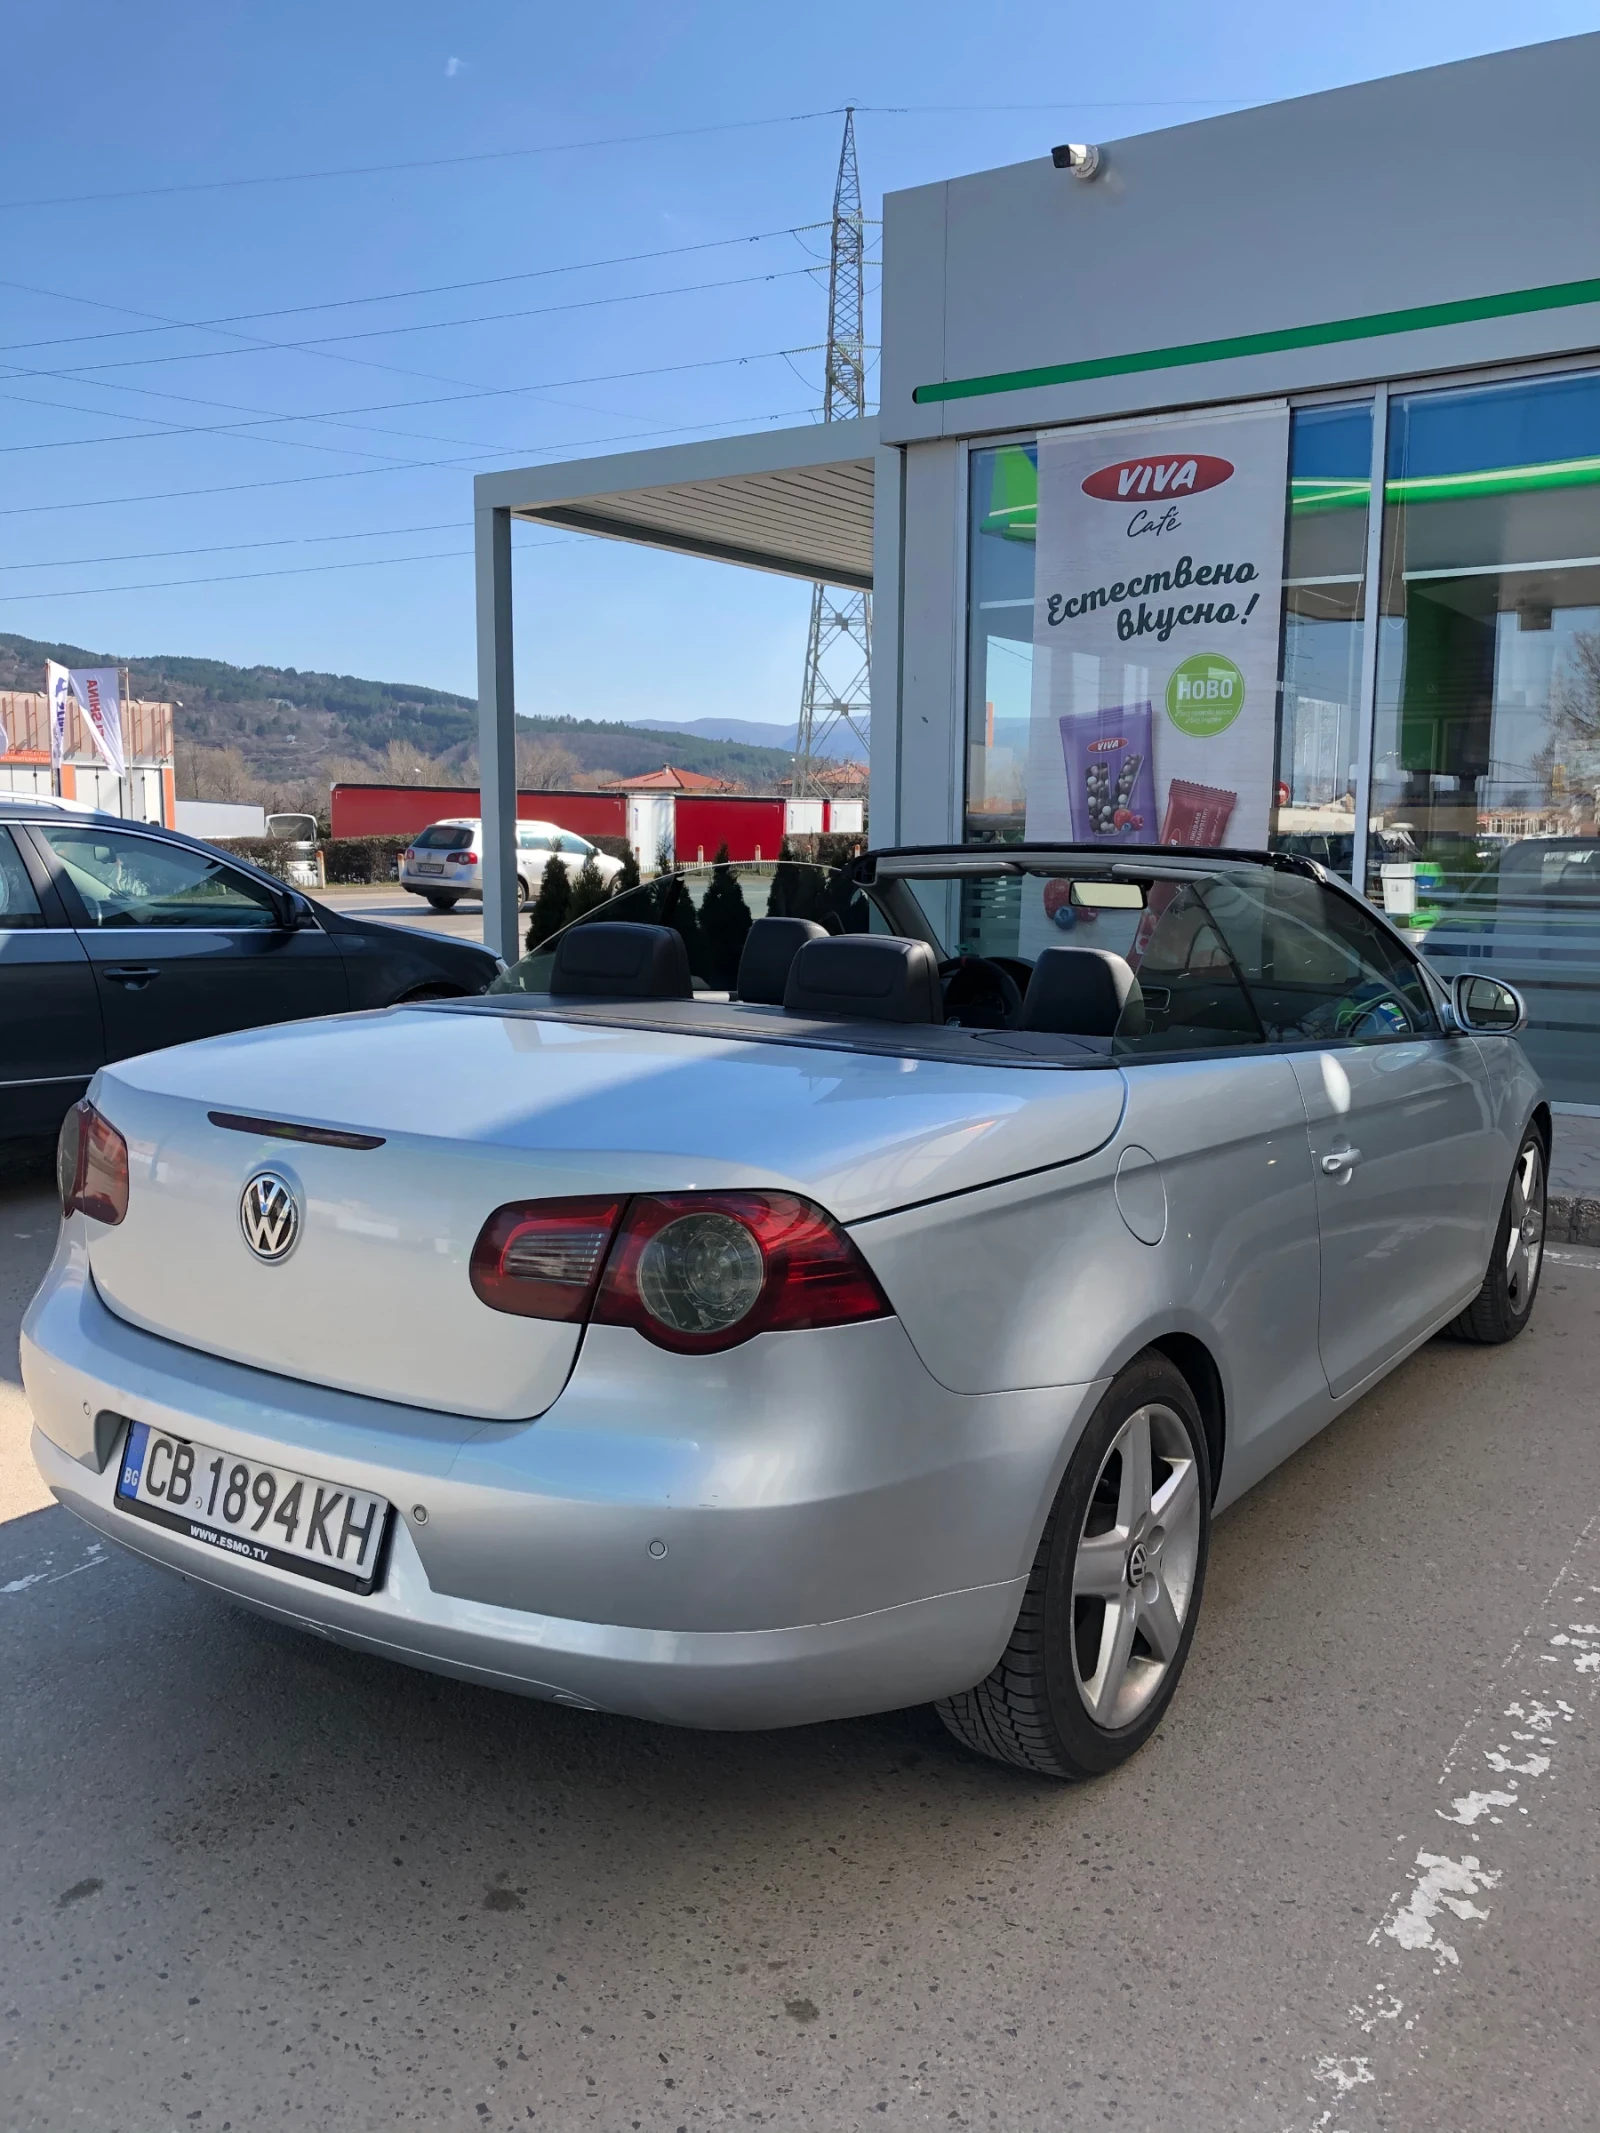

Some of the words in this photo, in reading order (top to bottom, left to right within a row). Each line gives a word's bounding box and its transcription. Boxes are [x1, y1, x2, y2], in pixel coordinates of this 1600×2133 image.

[1117, 460, 1198, 496] VIVA
[1127, 506, 1182, 538] Café
[1047, 555, 1260, 627] Естествено
[1116, 593, 1261, 642] вкусно!
[1178, 678, 1233, 700] НОВО
[1097, 740, 1119, 751] VIVA
[124, 1467, 139, 1488] BG
[190, 1525, 269, 1561] WWW.ESMO.TV
